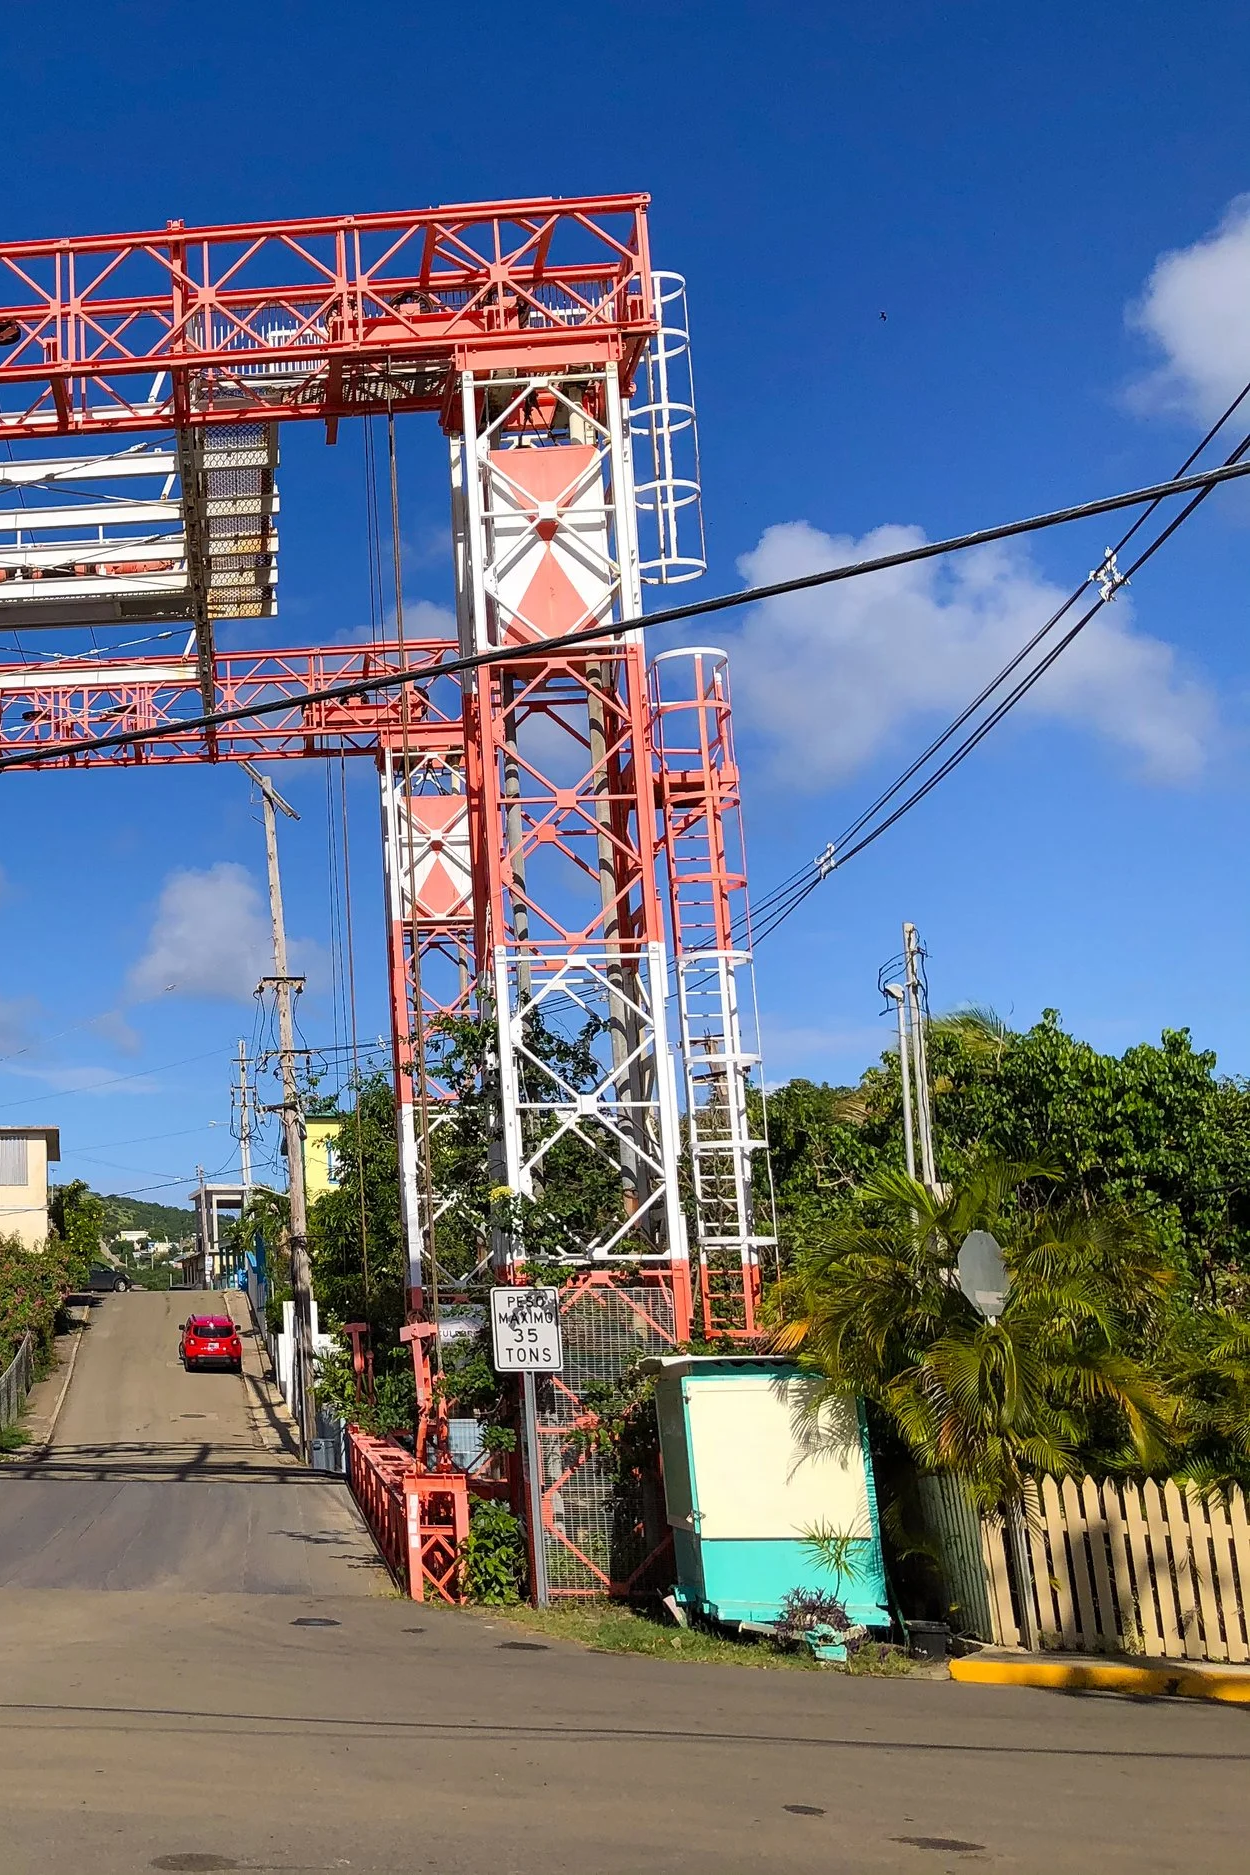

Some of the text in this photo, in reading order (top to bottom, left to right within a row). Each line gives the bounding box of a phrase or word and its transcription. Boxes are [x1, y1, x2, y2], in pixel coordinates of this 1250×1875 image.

[507, 1296, 545, 1308] PESO
[498, 1312, 553, 1324] MAXIMO
[514, 1328, 538, 1343] 35
[505, 1347, 552, 1363] TONS
